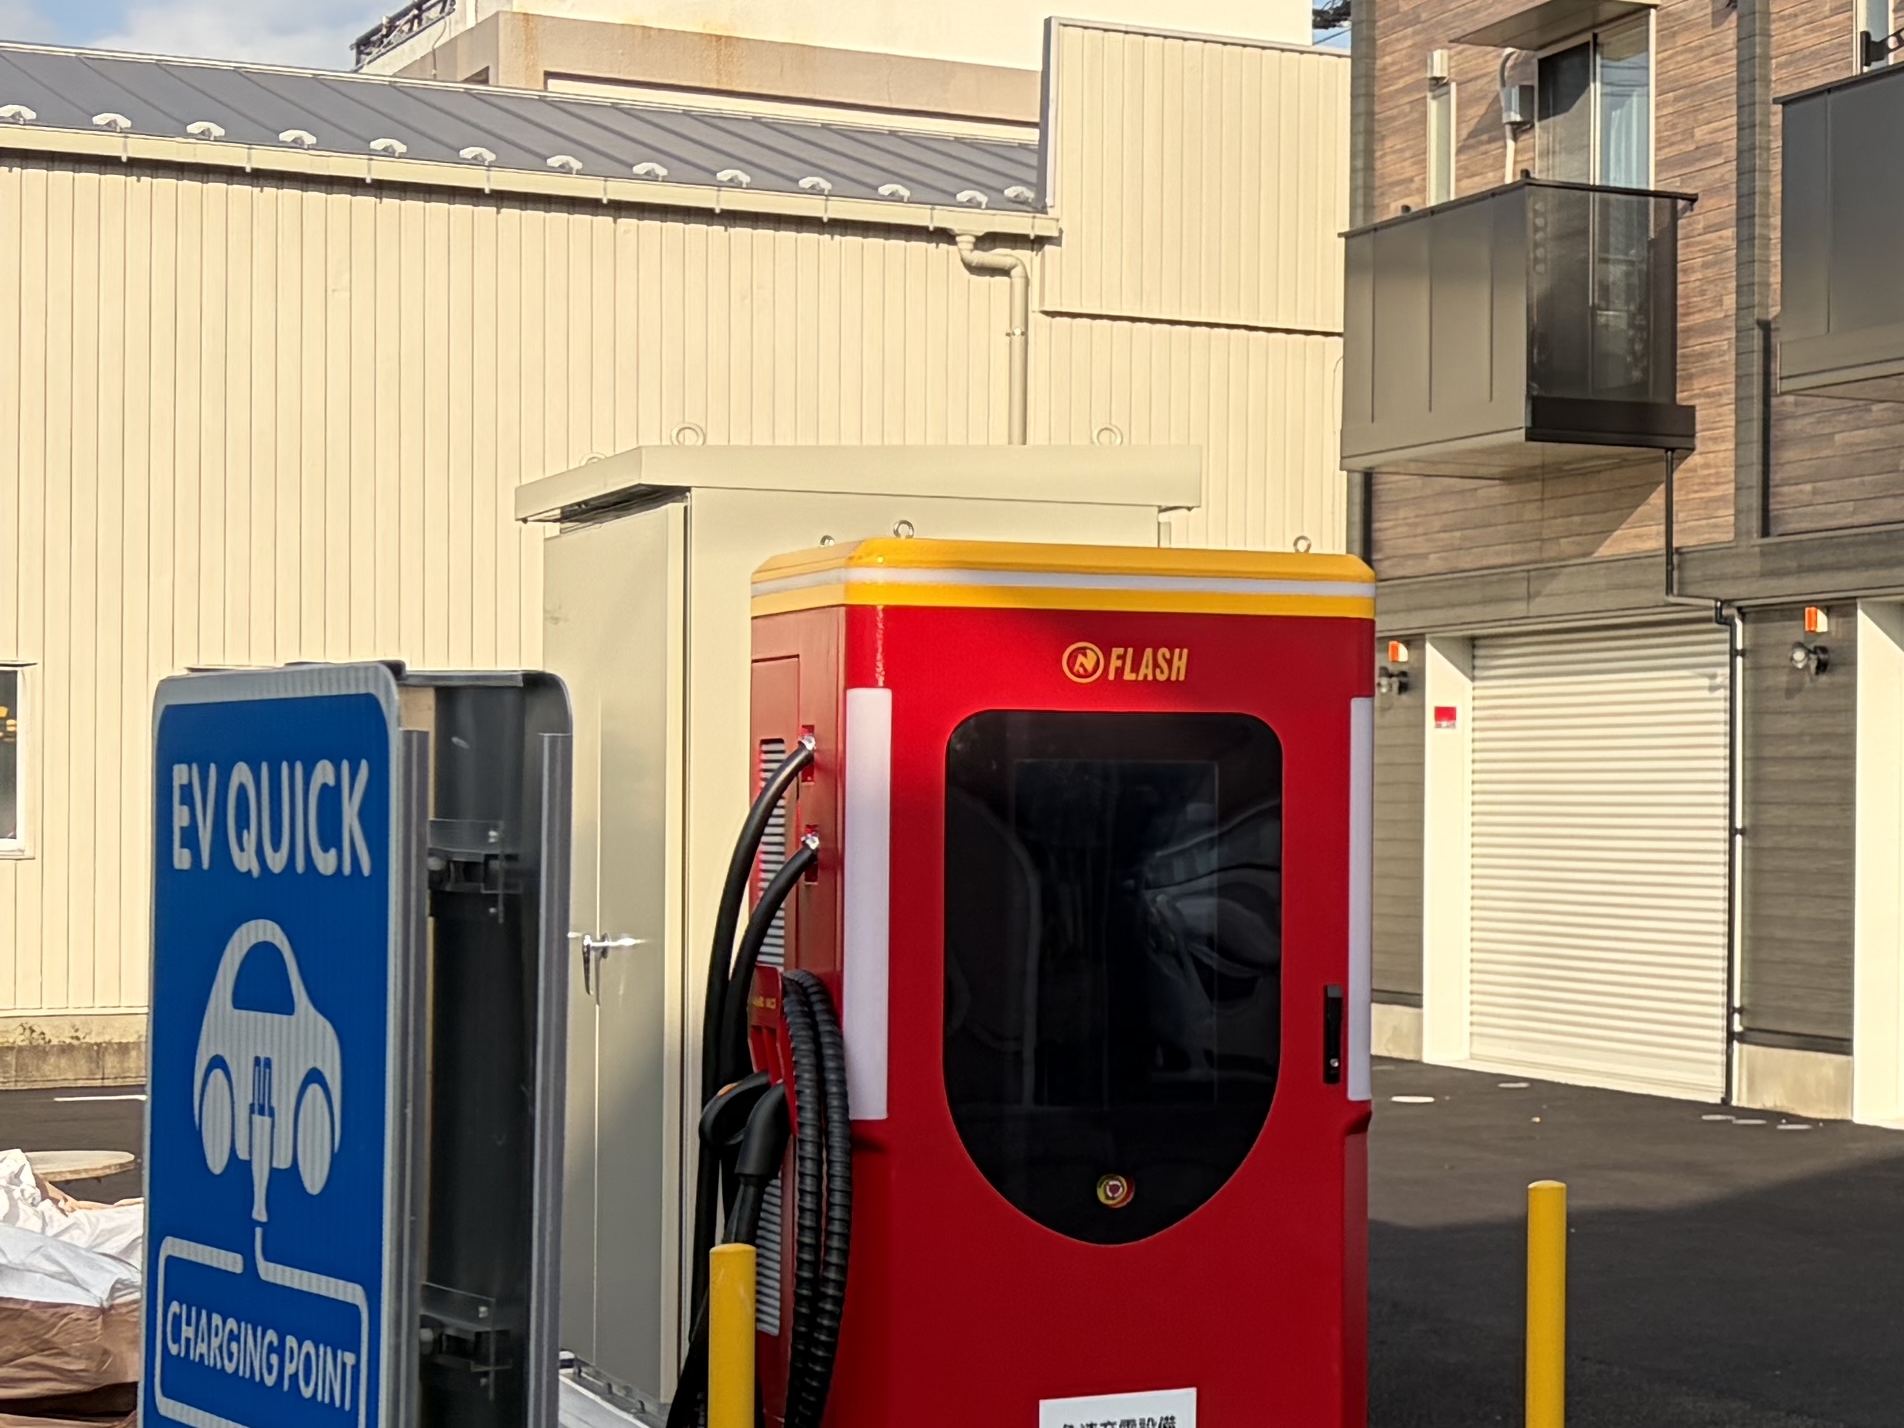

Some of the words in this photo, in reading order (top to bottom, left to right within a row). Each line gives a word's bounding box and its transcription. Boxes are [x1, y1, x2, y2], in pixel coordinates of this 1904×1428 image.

[1107, 647, 1189, 682] FLASH
[172, 762, 218, 871] EV
[226, 758, 371, 879] QUICK
[166, 1299, 279, 1387] CHARGING
[282, 1333, 357, 1412] POINT
